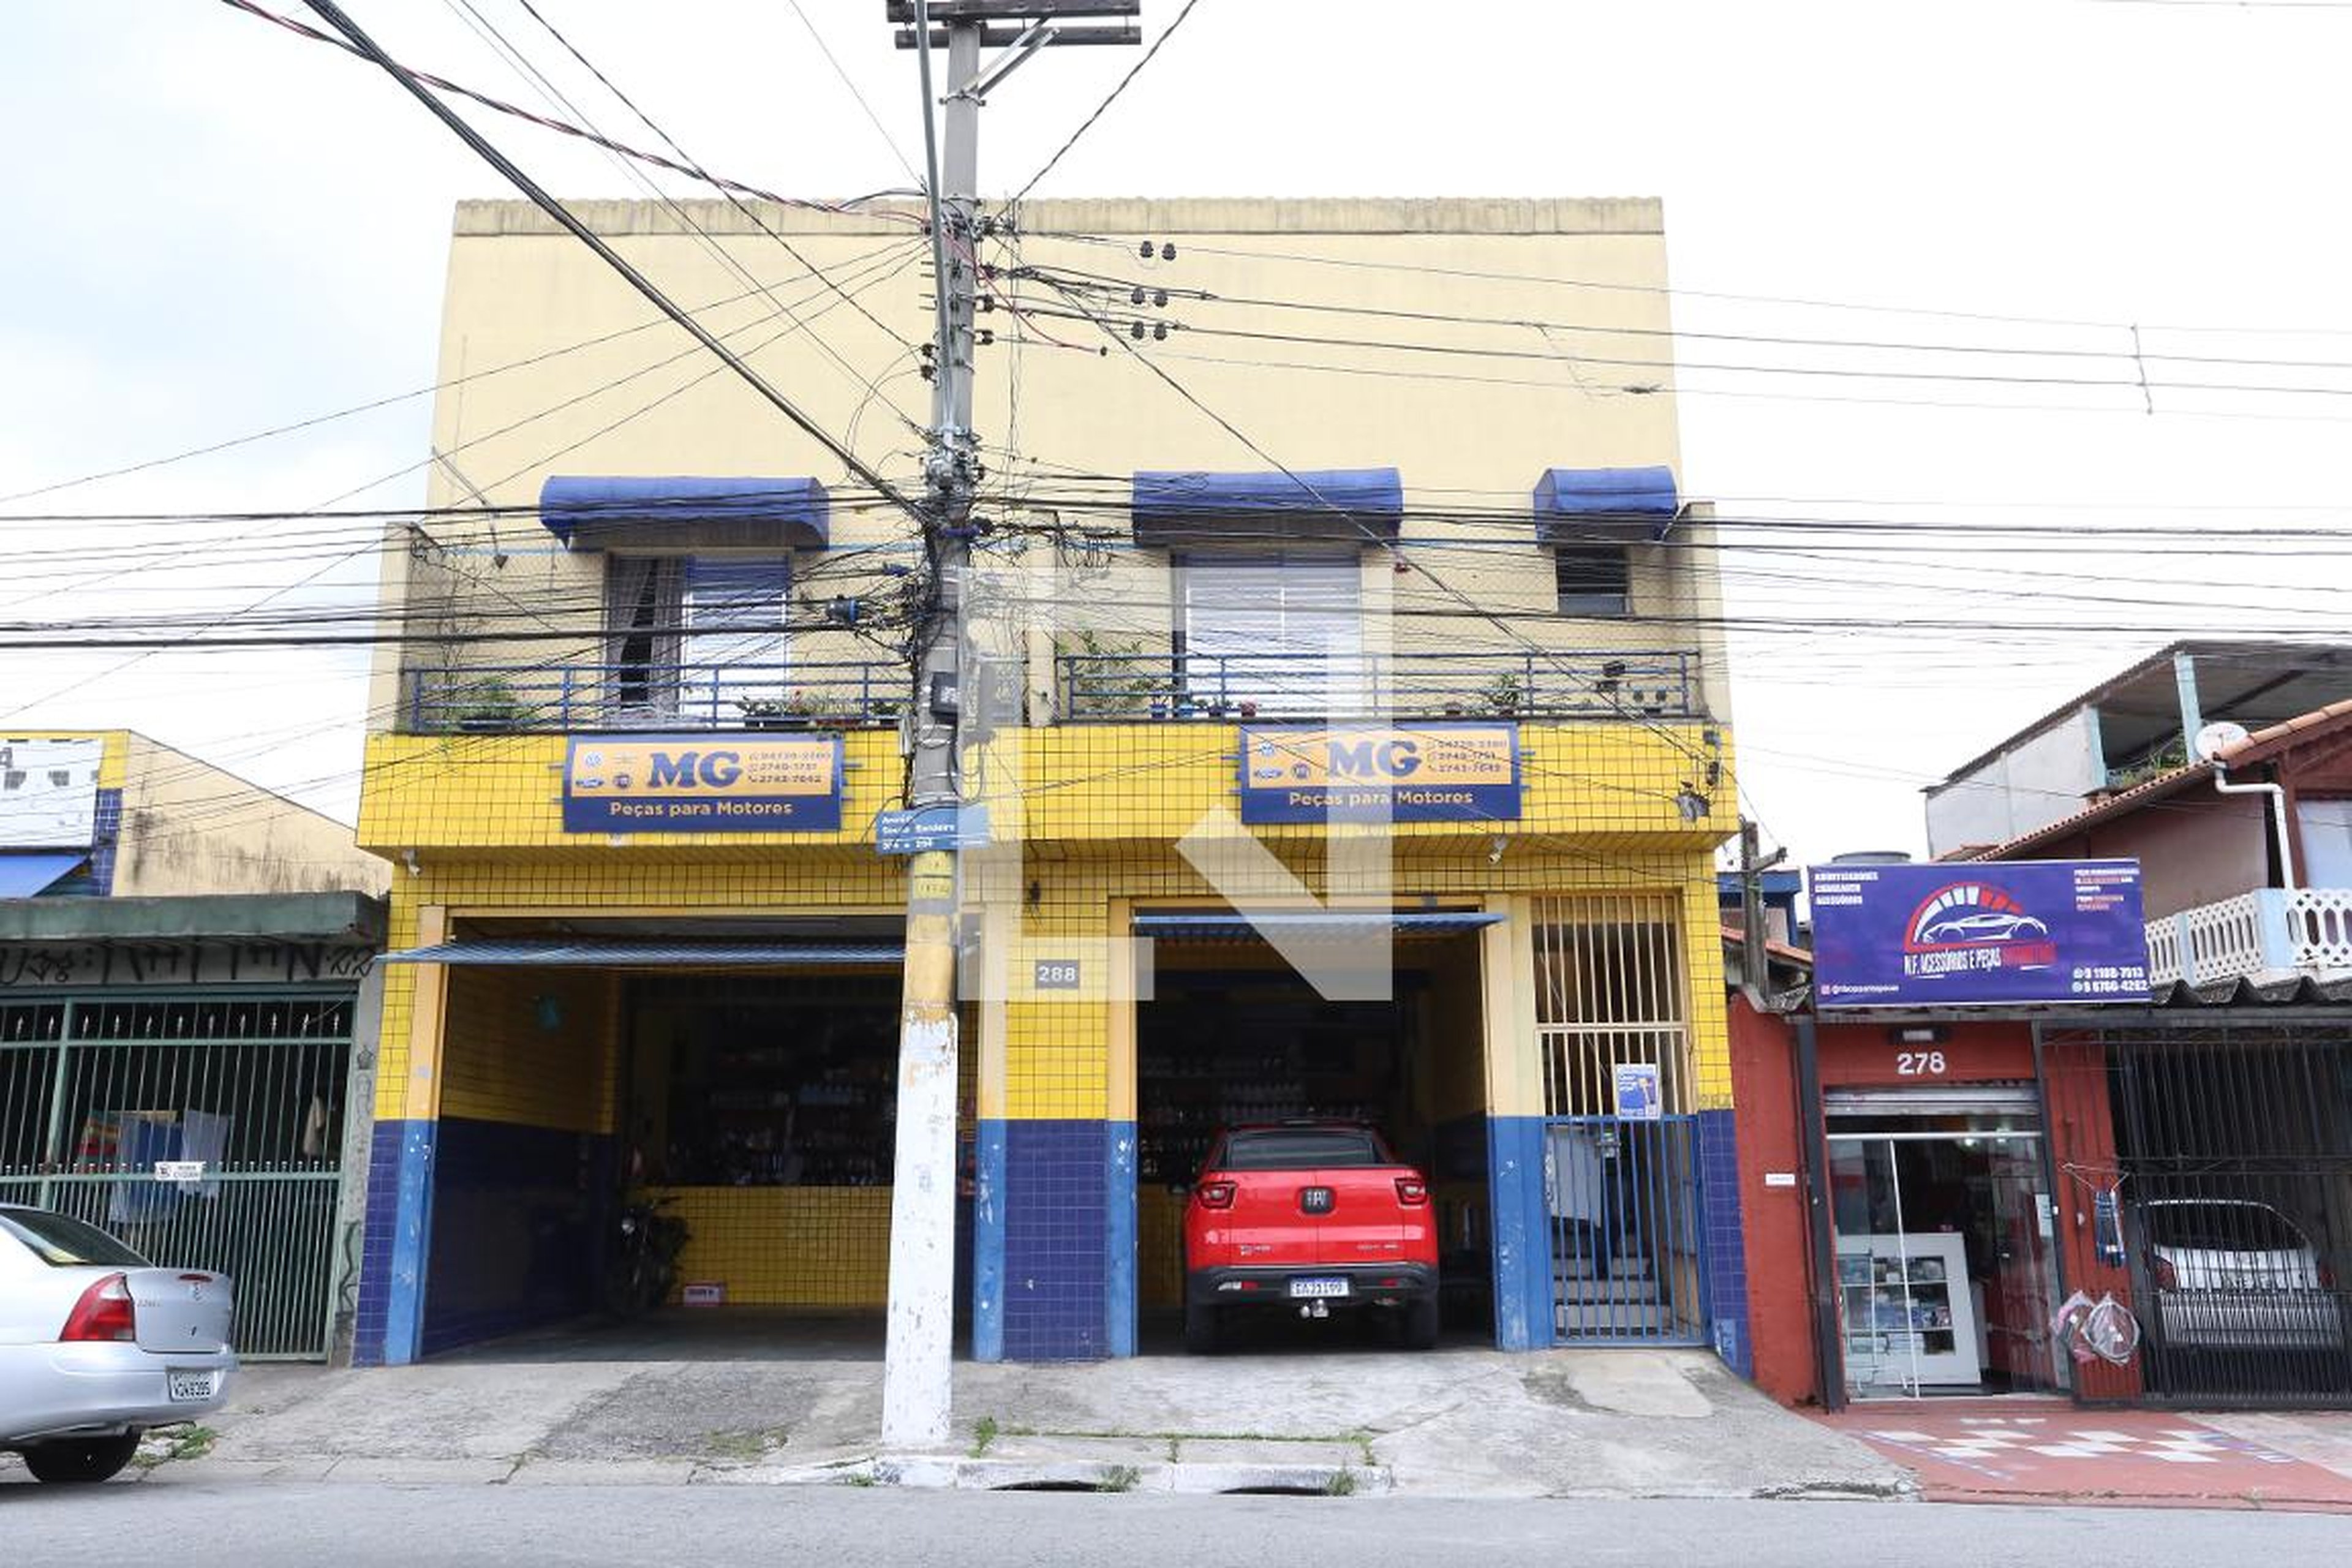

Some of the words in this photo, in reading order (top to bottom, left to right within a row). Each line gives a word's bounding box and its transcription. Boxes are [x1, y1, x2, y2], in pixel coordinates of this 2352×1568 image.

[1327, 739, 1422, 778] MG
[649, 752, 742, 788] MG
[1289, 791, 1343, 807] Peças
[1349, 792, 1390, 807] para
[1397, 790, 1473, 805] Motores
[610, 801, 663, 818] Peças
[669, 804, 710, 818] para
[717, 801, 793, 815] Motores
[1969, 949, 1976, 969] E
[1037, 965, 1077, 982] 288
[1896, 1051, 1946, 1075] 278
